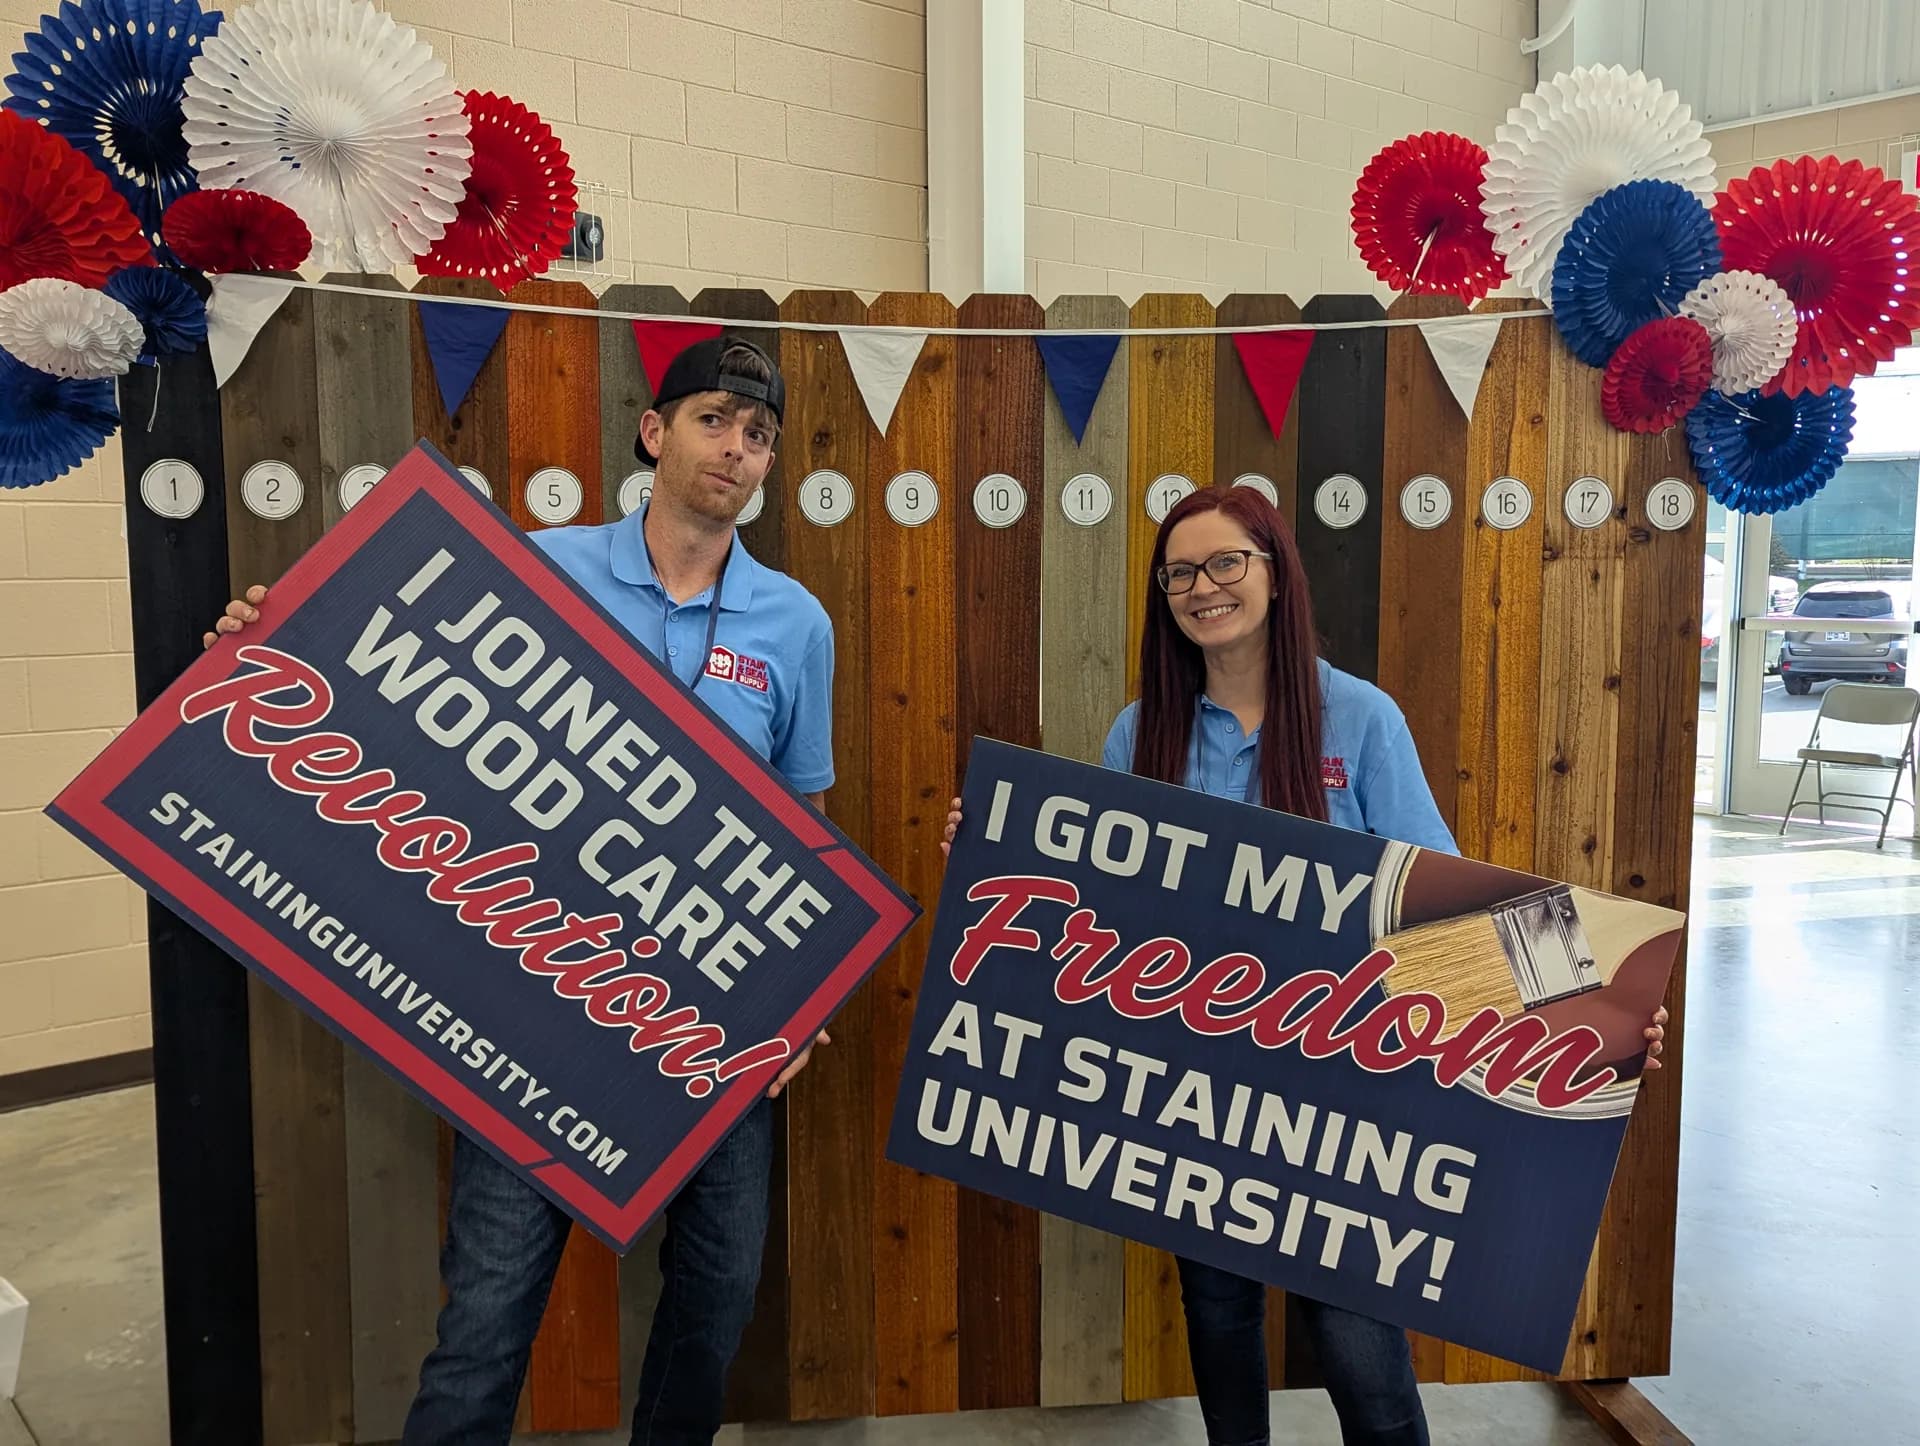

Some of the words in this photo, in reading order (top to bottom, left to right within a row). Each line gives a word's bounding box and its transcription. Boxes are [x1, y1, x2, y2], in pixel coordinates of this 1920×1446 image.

[169, 477, 178, 502] 1
[266, 478, 281, 502] 2
[547, 484, 562, 508] 5
[819, 486, 833, 510] 8
[905, 487, 919, 510] 9
[988, 488, 1010, 512] 10
[1078, 488, 1093, 511] 11
[1331, 490, 1351, 513] 14
[1417, 490, 1436, 513] 15
[1497, 492, 1517, 515] 16
[1580, 491, 1600, 514] 17
[1660, 494, 1680, 517] 18
[738, 654, 768, 670] STAIN
[745, 666, 769, 681] SEAL
[739, 674, 765, 689] SUPPLY
[396, 547, 456, 606] I
[434, 591, 697, 826] JOINED
[693, 804, 832, 950] THE
[1322, 777, 1344, 787] PPLY
[345, 604, 584, 831] WOOD
[578, 818, 767, 993] CARE
[984, 780, 1014, 842] I
[1034, 794, 1207, 891] GOT
[1223, 844, 1374, 935] MY
[179, 645, 790, 1098] Revolution!
[149, 792, 628, 1176] STAININGUNIVERSITY.COM
[949, 875, 1618, 1111] Freedom
[927, 1000, 1044, 1079] AT
[1057, 1036, 1477, 1215] STAINING
[916, 1078, 1456, 1303] UNIVERSITY!
